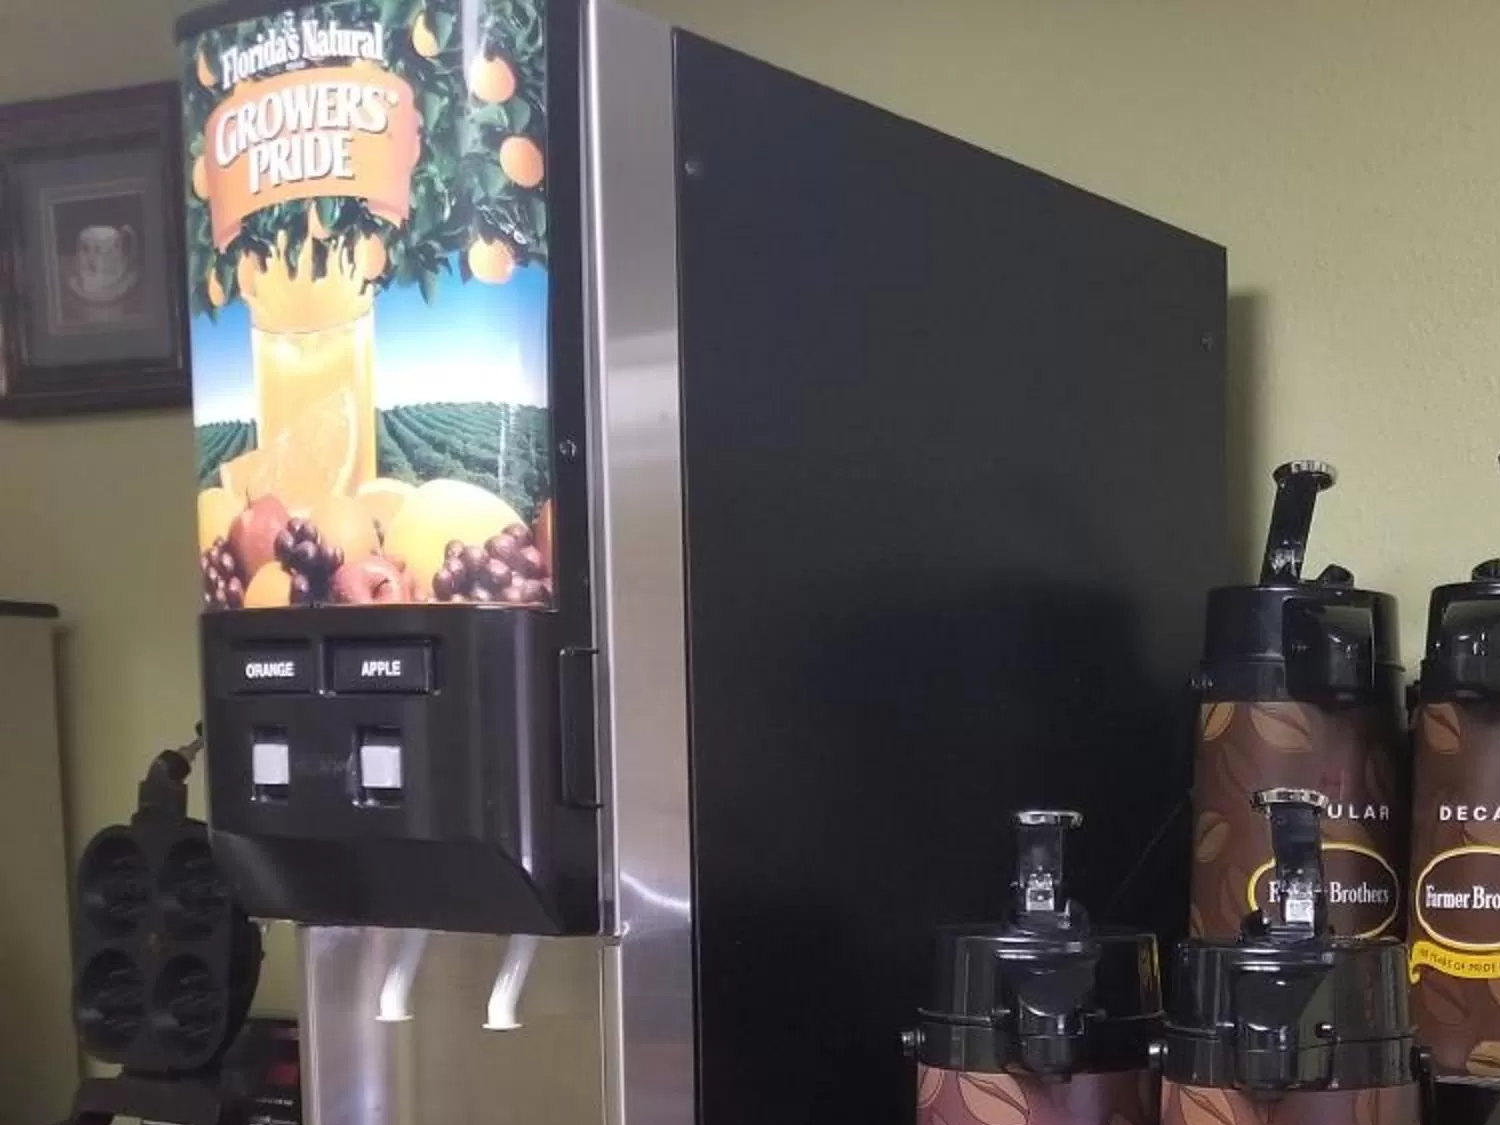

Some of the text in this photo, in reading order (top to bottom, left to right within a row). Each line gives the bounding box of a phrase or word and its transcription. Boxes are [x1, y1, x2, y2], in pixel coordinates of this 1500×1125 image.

[220, 19, 385, 90] Florida's Natural
[251, 131, 355, 194] PRIDE
[245, 661, 295, 678] ORANGE
[361, 660, 401, 677] APPLE
[1327, 803, 1389, 820] ULAR
[1329, 881, 1389, 903] Brothers
[1425, 884, 1471, 909] Farmer
